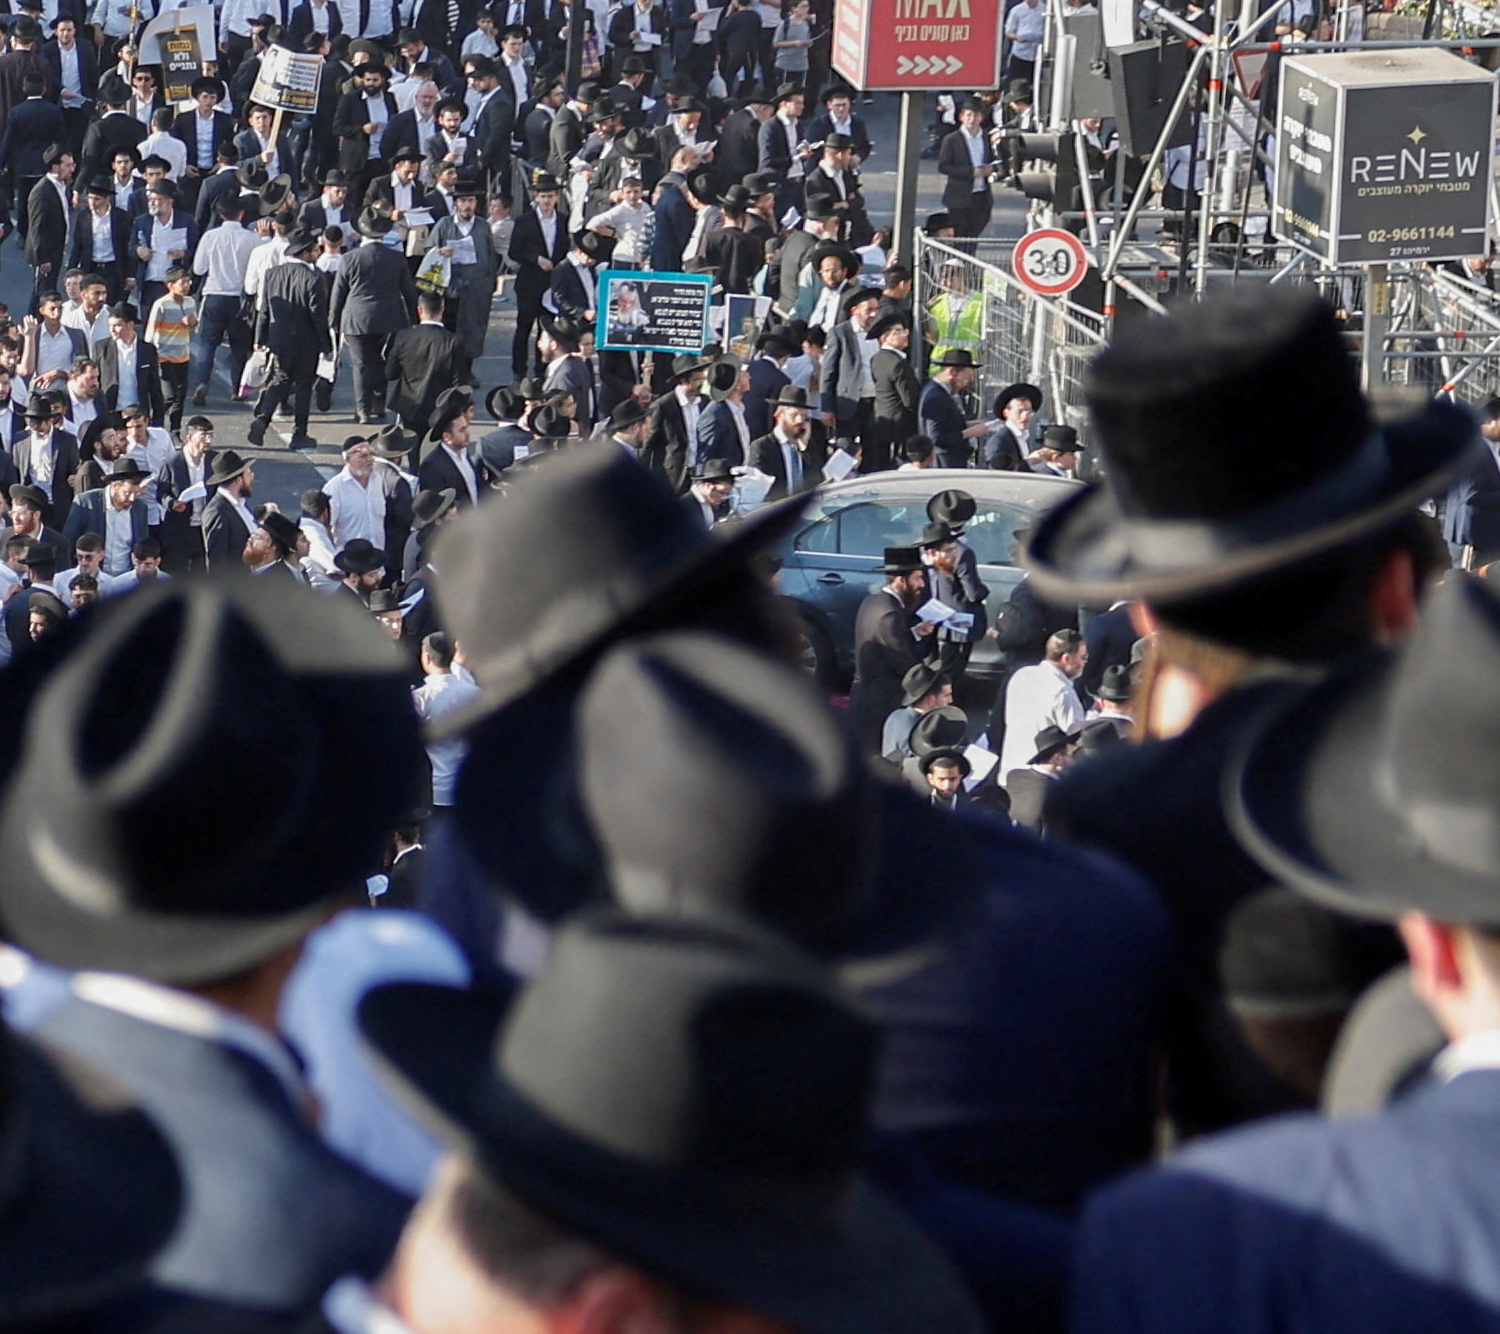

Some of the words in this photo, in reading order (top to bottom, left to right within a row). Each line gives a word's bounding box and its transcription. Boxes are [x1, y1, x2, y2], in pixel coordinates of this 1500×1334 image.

[920, 24, 950, 42] קונים
[951, 24, 970, 42] כאן
[173, 51, 190, 62] ולא
[1357, 185, 1402, 197] מעוצבים
[1403, 183, 1433, 196] יוקרה
[1435, 181, 1470, 192] מטבחי
[1368, 225, 1455, 243] 02-9661144
[1389, 247, 1402, 256] 27
[1028, 248, 1071, 277] 30
